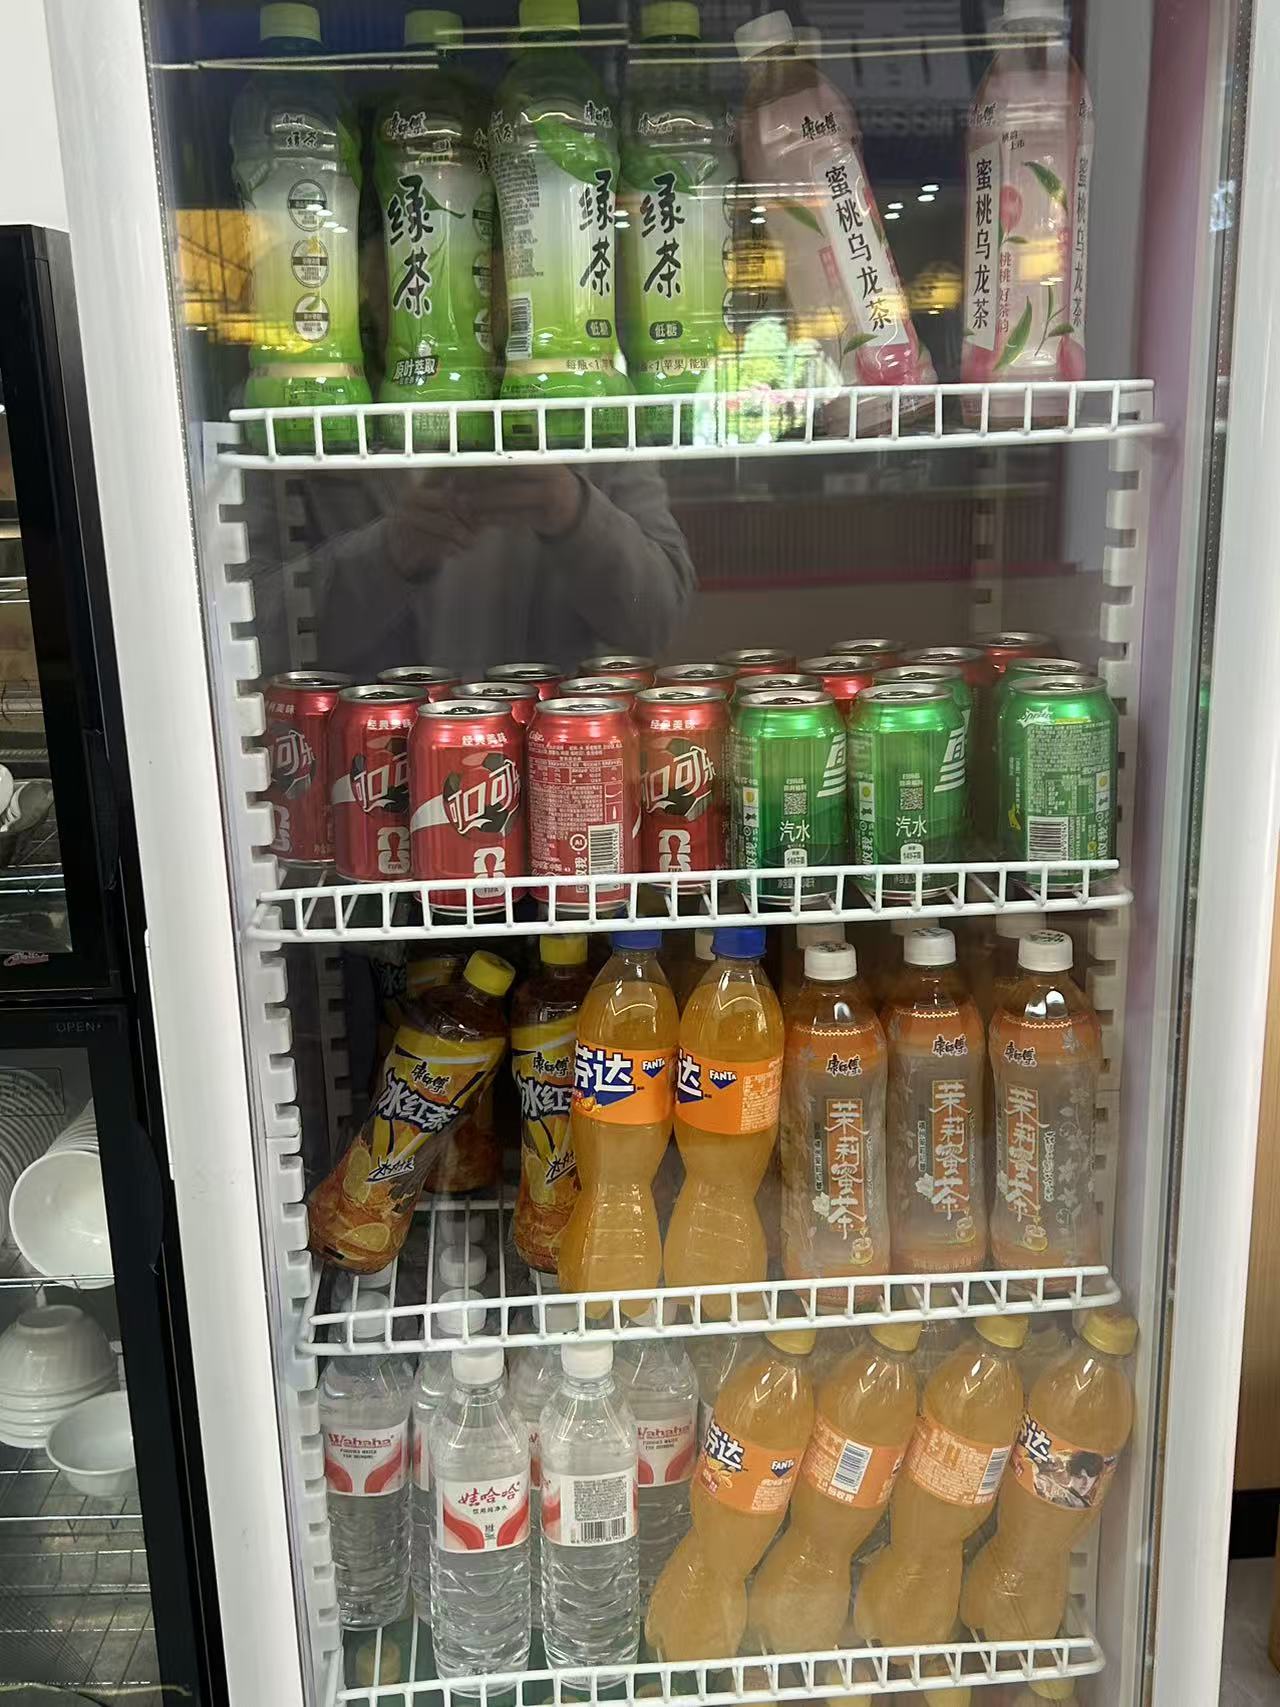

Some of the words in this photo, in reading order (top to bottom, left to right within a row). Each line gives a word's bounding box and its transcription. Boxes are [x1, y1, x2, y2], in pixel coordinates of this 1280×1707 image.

[802, 112, 842, 141] 康师傅
[388, 174, 433, 317] 绿茶
[579, 170, 613, 297] 绿茶
[640, 172, 685, 299] 绿茶
[973, 158, 992, 329] 蜜桃乌龙茶
[825, 165, 892, 332] 蜜桃乌龙茶
[655, 323, 678, 337] 低糖
[394, 358, 437, 381] 原叶萃取
[650, 719, 697, 730] 经典美味
[462, 732, 508, 746] 经典美味
[640, 745, 716, 814] 可口可乐
[780, 820, 810, 842] 汽水
[896, 815, 927, 838] 汽水
[56, 1022, 95, 1032] OPEN
[934, 1035, 968, 1056] 康师傅
[1005, 1041, 1036, 1066] 康师傅
[533, 1051, 570, 1076] 康师傅
[642, 1057, 665, 1073] FANTA
[827, 1054, 862, 1076] 康师傅
[411, 1060, 451, 1095] 康师傅
[709, 1070, 737, 1083] FANTA
[377, 1068, 461, 1133] 冰红茶
[929, 1082, 972, 1221] 茉莉蜜茶
[1004, 1087, 1050, 1222] 茉莉蜜茶
[824, 1102, 870, 1240] 茉莉蜜茶
[328, 1433, 392, 1448] Wahaha
[458, 1481, 519, 1507] 娃哈哈
